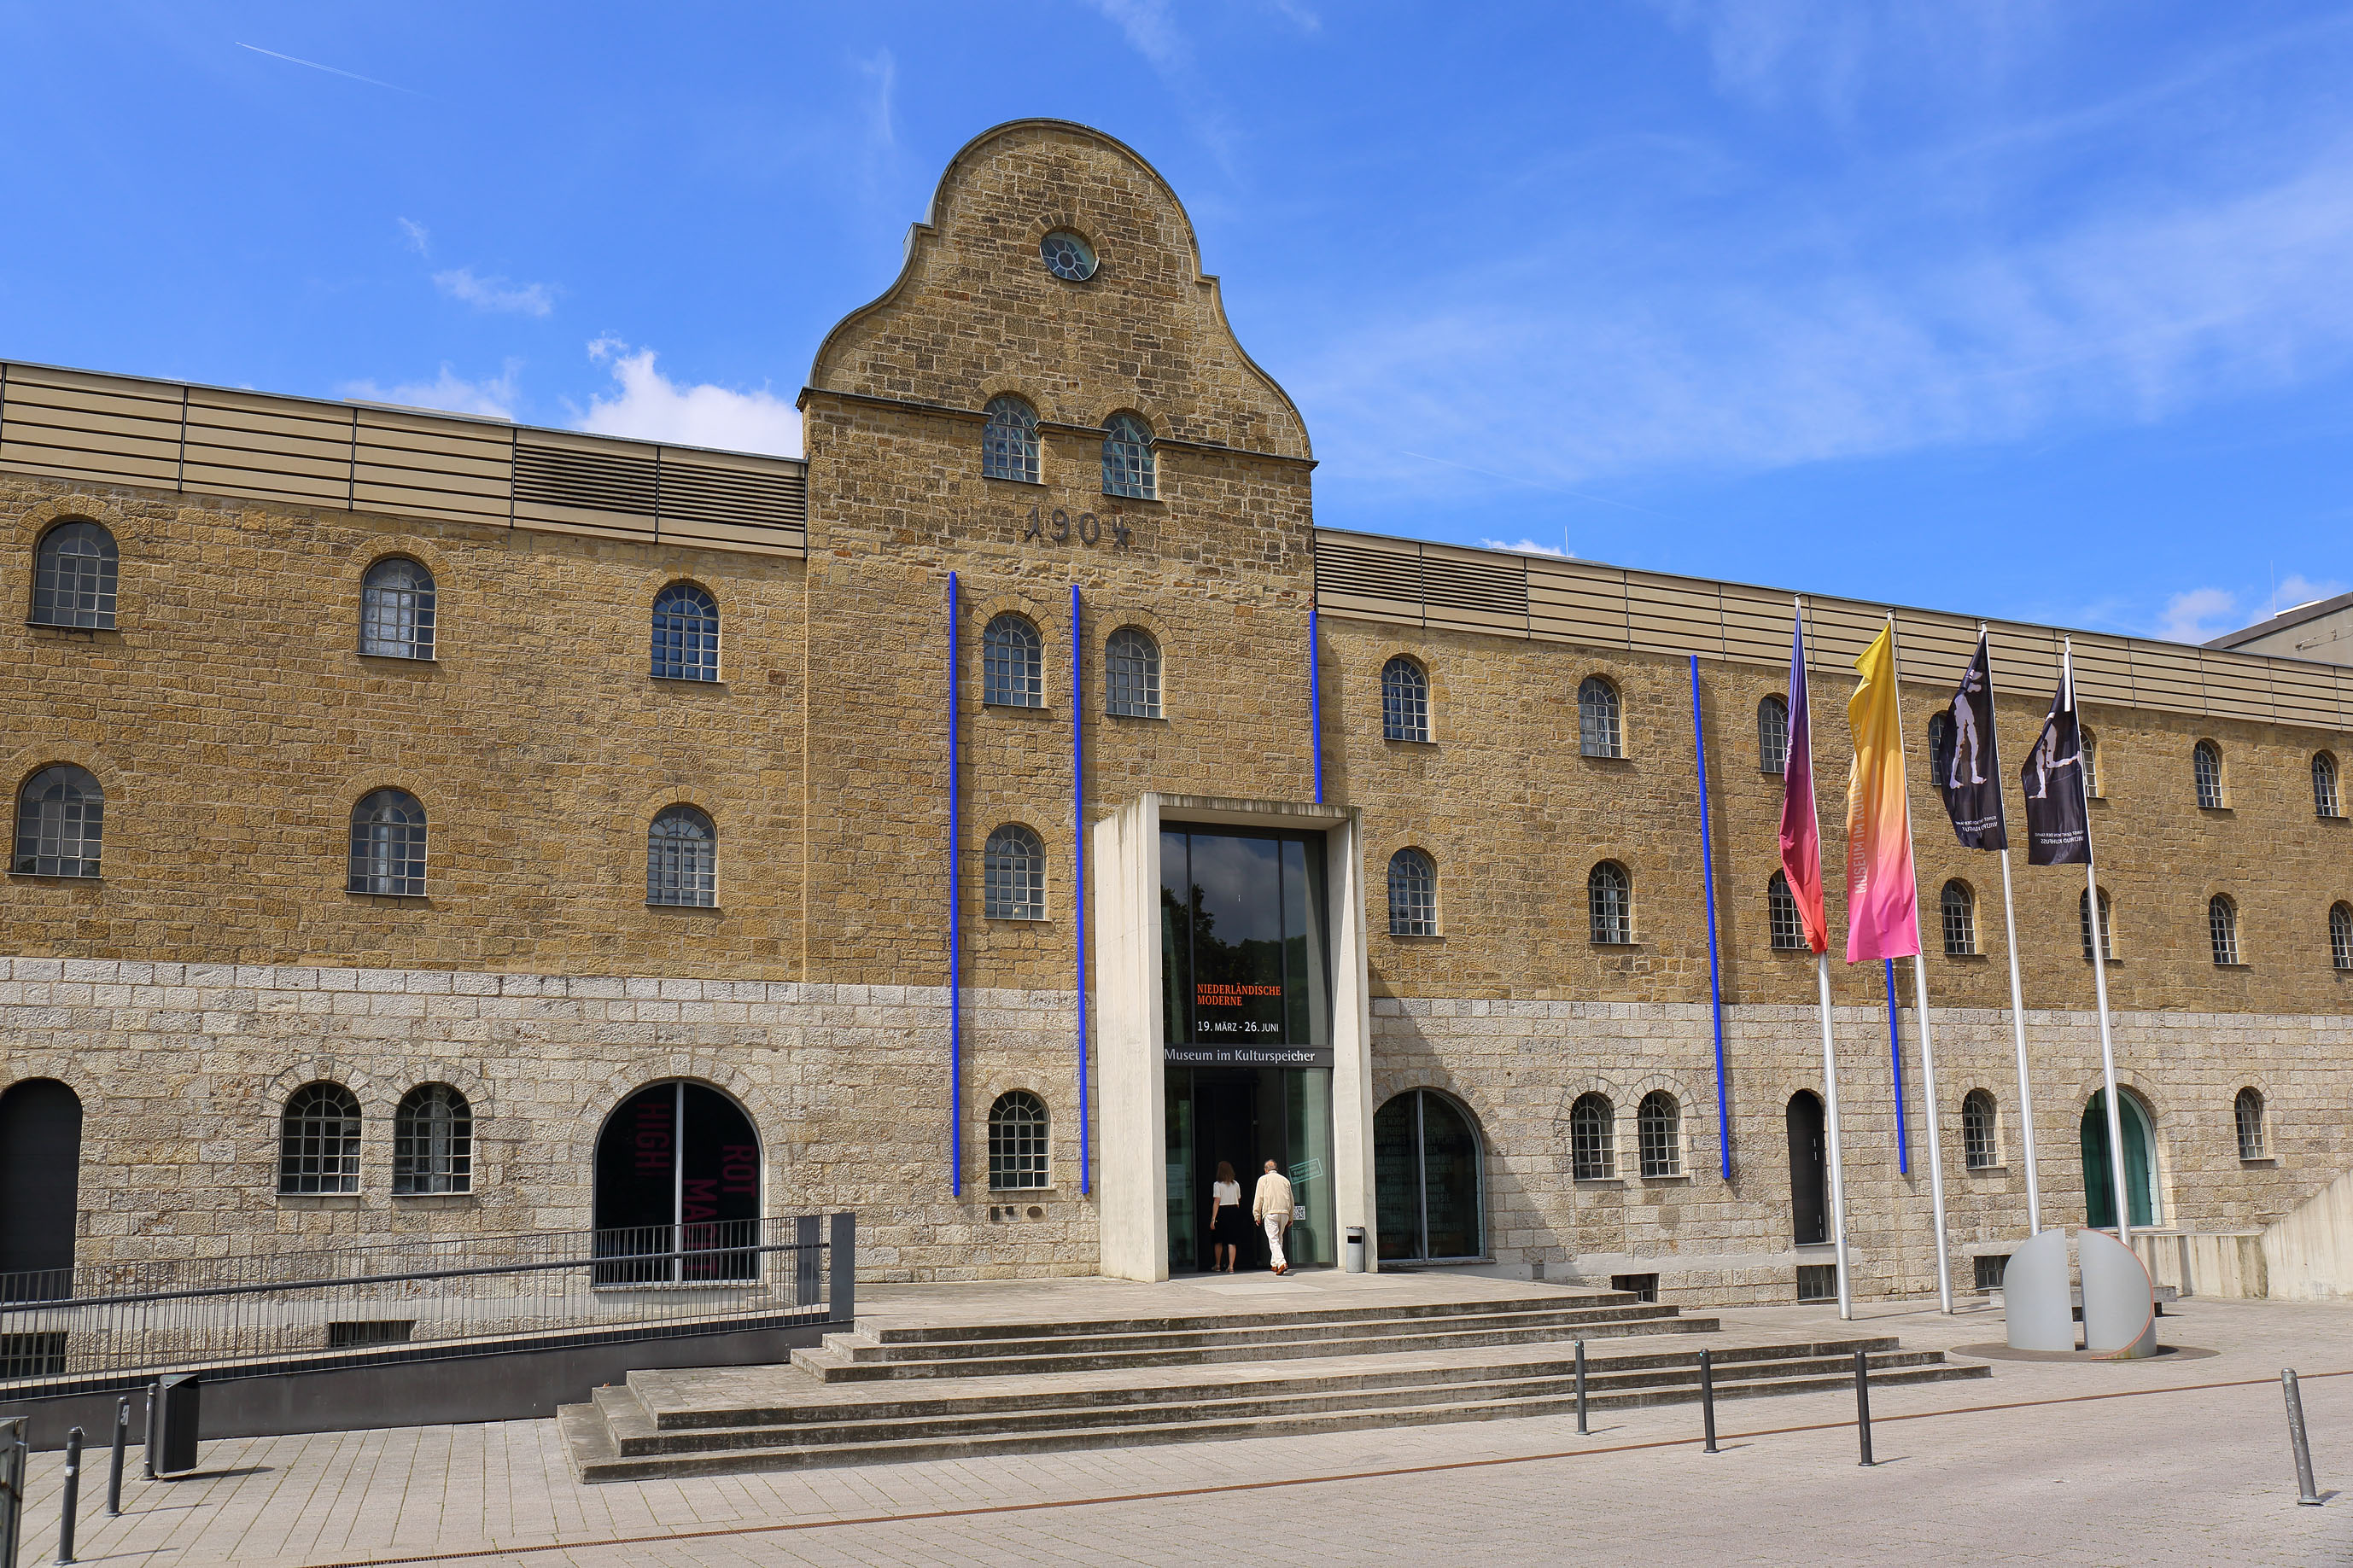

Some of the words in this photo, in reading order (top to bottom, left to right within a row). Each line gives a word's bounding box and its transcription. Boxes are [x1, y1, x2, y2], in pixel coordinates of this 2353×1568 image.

[1025, 506, 1131, 548] 1904
[1854, 823, 1865, 837] IM
[1854, 841, 1867, 895] MUSEUM
[1197, 982, 1282, 996] NIEDERLÄNDISCHE
[1197, 995, 1242, 1006] MODERNE
[1197, 1020, 1213, 1032] 19.
[1214, 1021, 1237, 1032] MÄRZ
[1244, 1021, 1260, 1032] 26.
[1261, 1023, 1279, 1033] JUNI
[1164, 1048, 1213, 1061] Museum
[1217, 1049, 1231, 1061] im
[1235, 1049, 1316, 1064] Kulturspeicher
